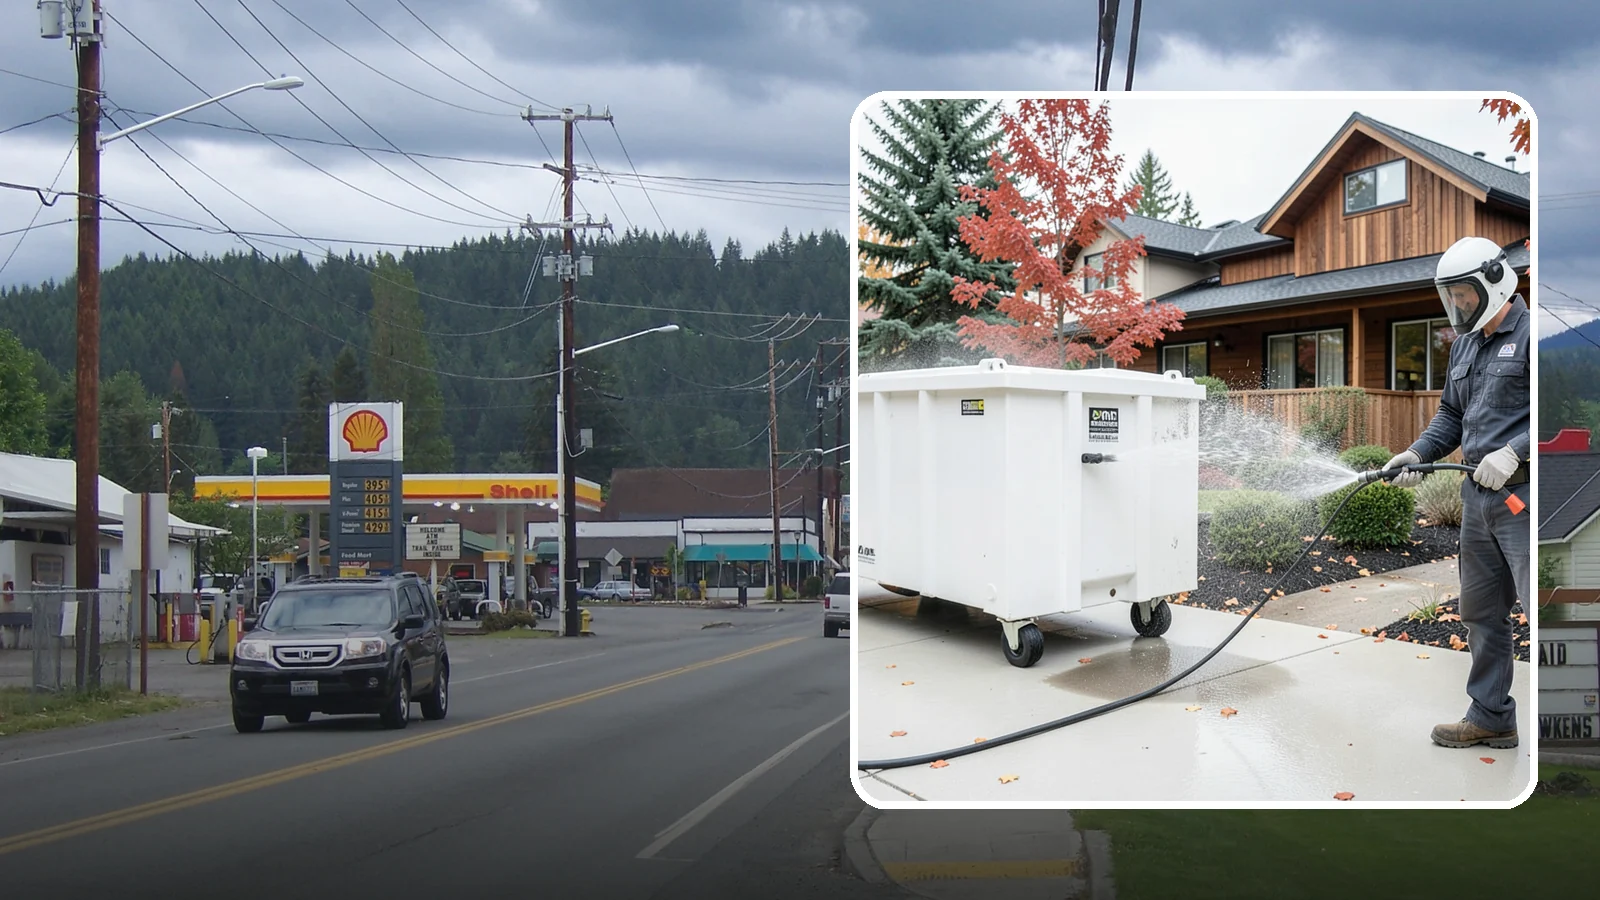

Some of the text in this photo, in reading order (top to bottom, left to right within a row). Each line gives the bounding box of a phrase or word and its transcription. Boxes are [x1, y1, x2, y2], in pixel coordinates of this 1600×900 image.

[366, 480, 384, 490] 395
[490, 484, 548, 499] Shell
[366, 494, 384, 504] 405
[366, 508, 384, 518] 415
[366, 522, 384, 533] 429
